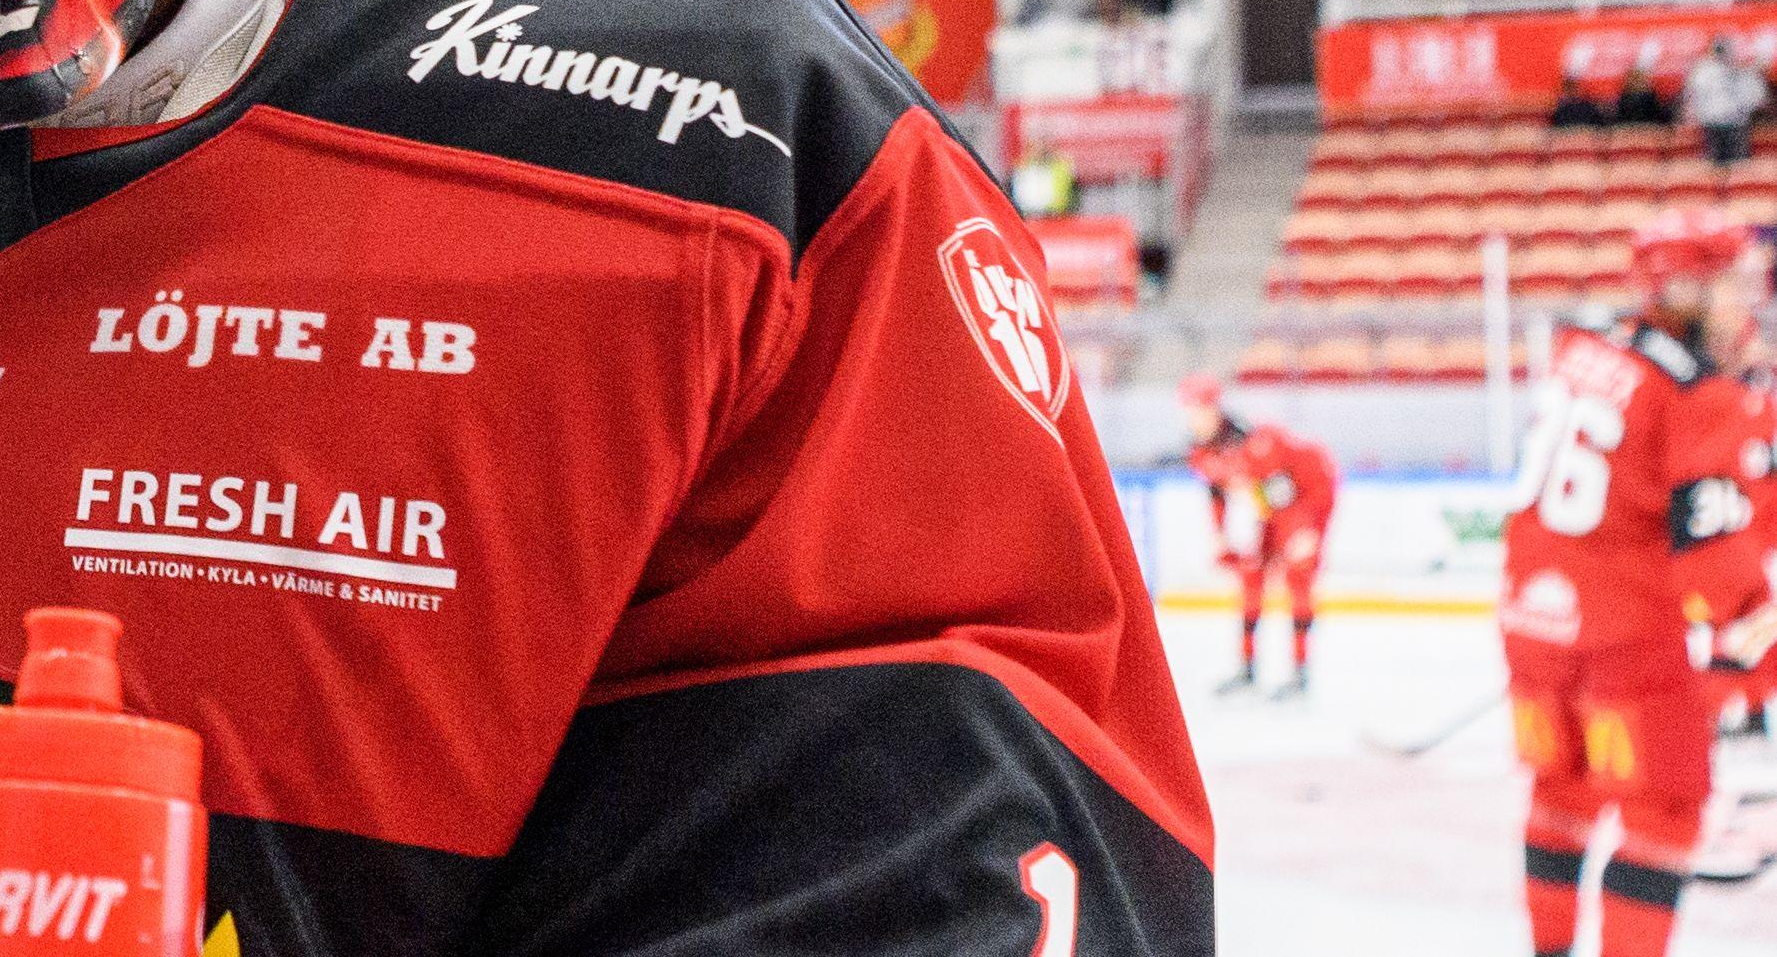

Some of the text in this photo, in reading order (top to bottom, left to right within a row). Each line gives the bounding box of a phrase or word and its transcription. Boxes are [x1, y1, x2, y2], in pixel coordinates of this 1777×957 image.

[89, 289, 477, 375] LÖJTE AB
[75, 467, 446, 560] FRESH AIR
[358, 585, 443, 613] SANITET
